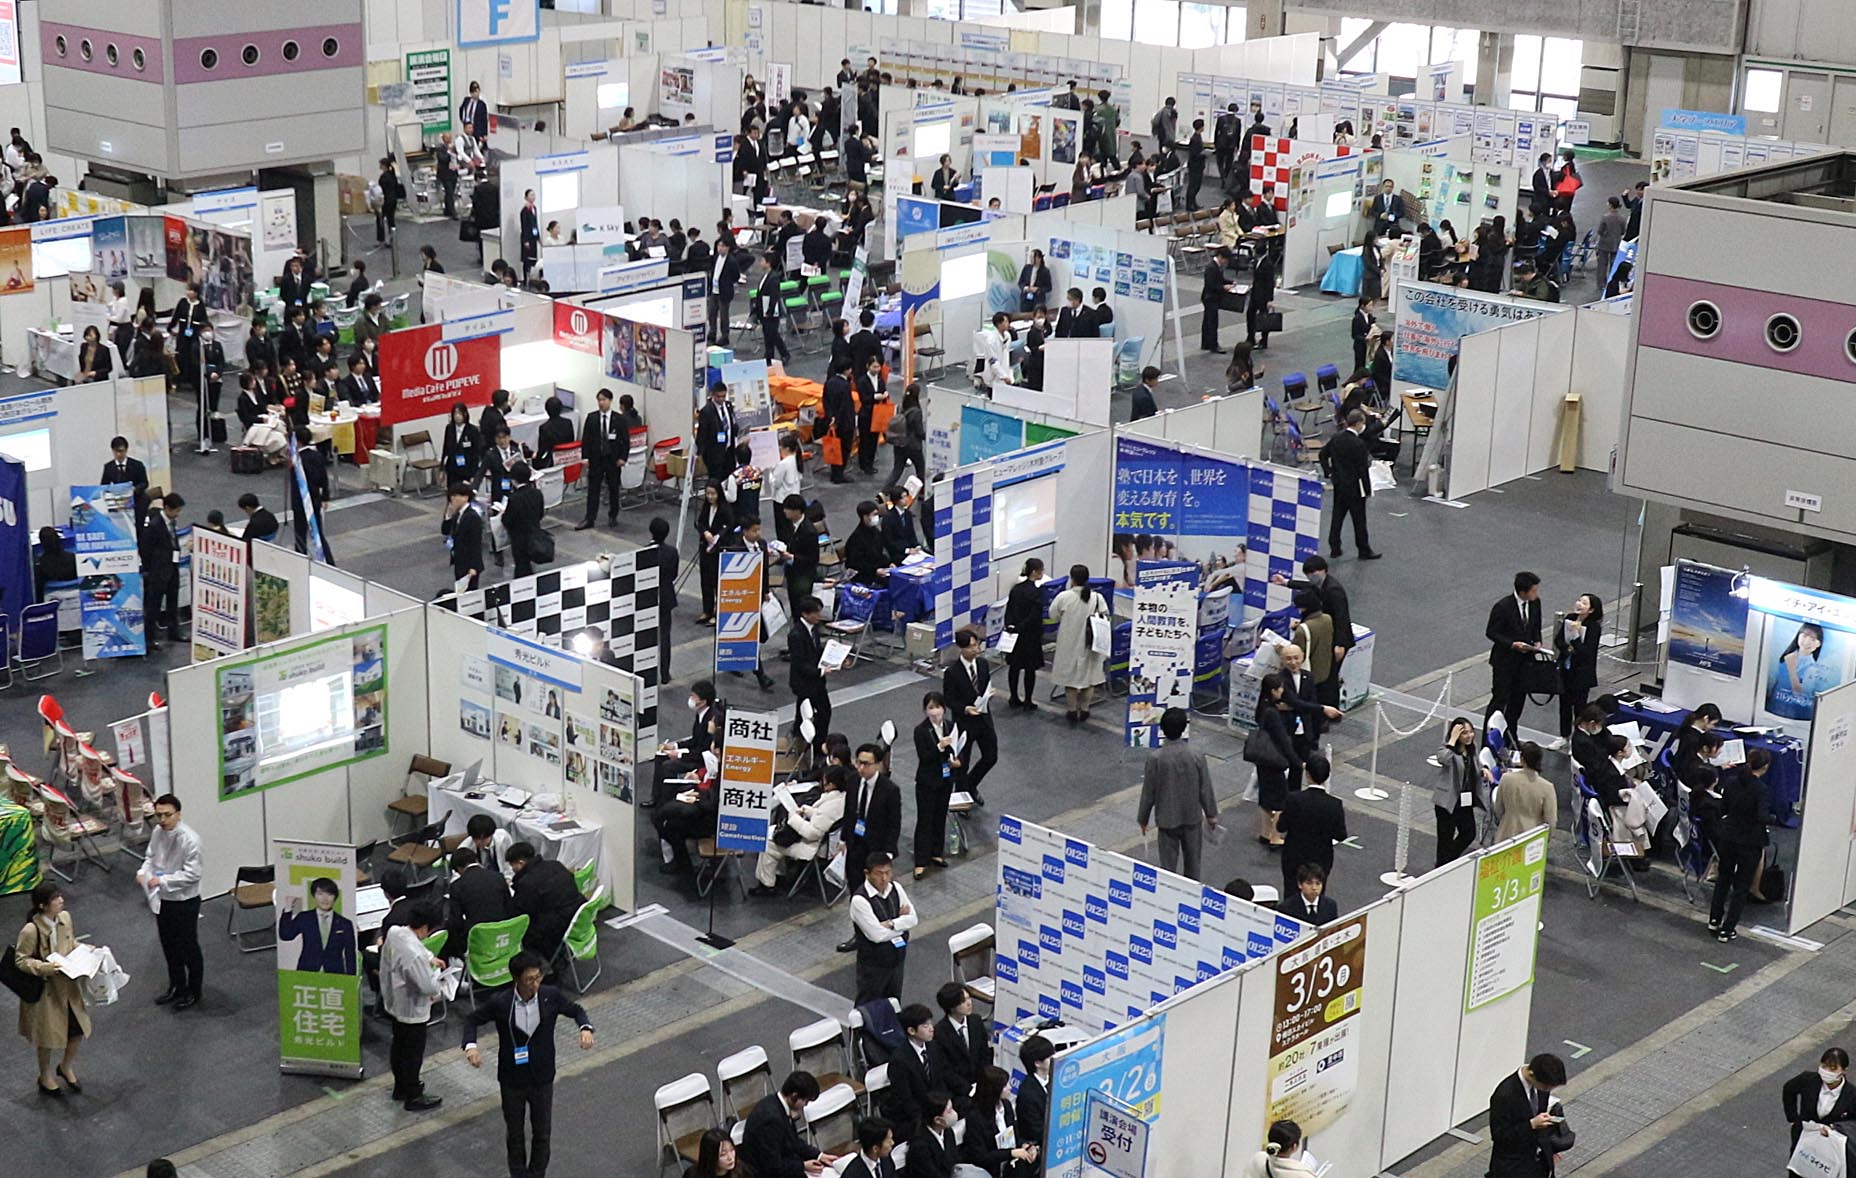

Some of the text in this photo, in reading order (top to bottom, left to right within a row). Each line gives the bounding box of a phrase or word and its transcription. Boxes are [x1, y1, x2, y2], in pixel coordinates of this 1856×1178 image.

[489, 0, 511, 35] F
[40, 222, 90, 235] LIFE CREATE
[426, 383, 444, 394] Cafe
[446, 374, 480, 390] POPEYE
[1117, 467, 1227, 486] 塾で日本を、世界を
[1118, 489, 1200, 508] 変える教育を。
[1116, 511, 1176, 529] 本気です。
[1137, 602, 1168, 613] 本物の
[1137, 615, 1190, 628] 人間教育を、
[1136, 626, 1191, 640] 子どもたちへ
[729, 718, 773, 741] 商社
[726, 754, 766, 764] エネルギー
[725, 764, 751, 772] Energy
[723, 788, 767, 810] 商社
[720, 831, 766, 841] Construction
[1000, 824, 1021, 838] 0123
[295, 853, 348, 864] shuko build
[1065, 847, 1087, 861] 0123
[1042, 862, 1064, 877] 0123
[1133, 872, 1156, 886] 0123
[1108, 887, 1131, 902] 0123
[1491, 879, 1518, 909] 3/3
[1085, 902, 1107, 916] 0123
[1202, 896, 1226, 913] 0123
[1063, 918, 1085, 932] 0123
[1040, 934, 1062, 948] 0123
[1154, 929, 1177, 943] 0123
[1018, 949, 1039, 963] 0123
[1129, 943, 1152, 958] 0123
[996, 963, 1018, 977] 0123
[1106, 960, 1128, 974] 0123
[1083, 975, 1105, 989] 0123
[1286, 955, 1334, 1013] 3/3
[293, 985, 345, 1010] 正直
[1061, 989, 1083, 1003] 0123
[1039, 1003, 1060, 1017] 0123
[293, 1010, 345, 1036] 住宅
[1100, 1109, 1137, 1137] 講演会場
[1101, 1124, 1133, 1153] 受付
[1811, 1156, 1832, 1174] マイナビ
